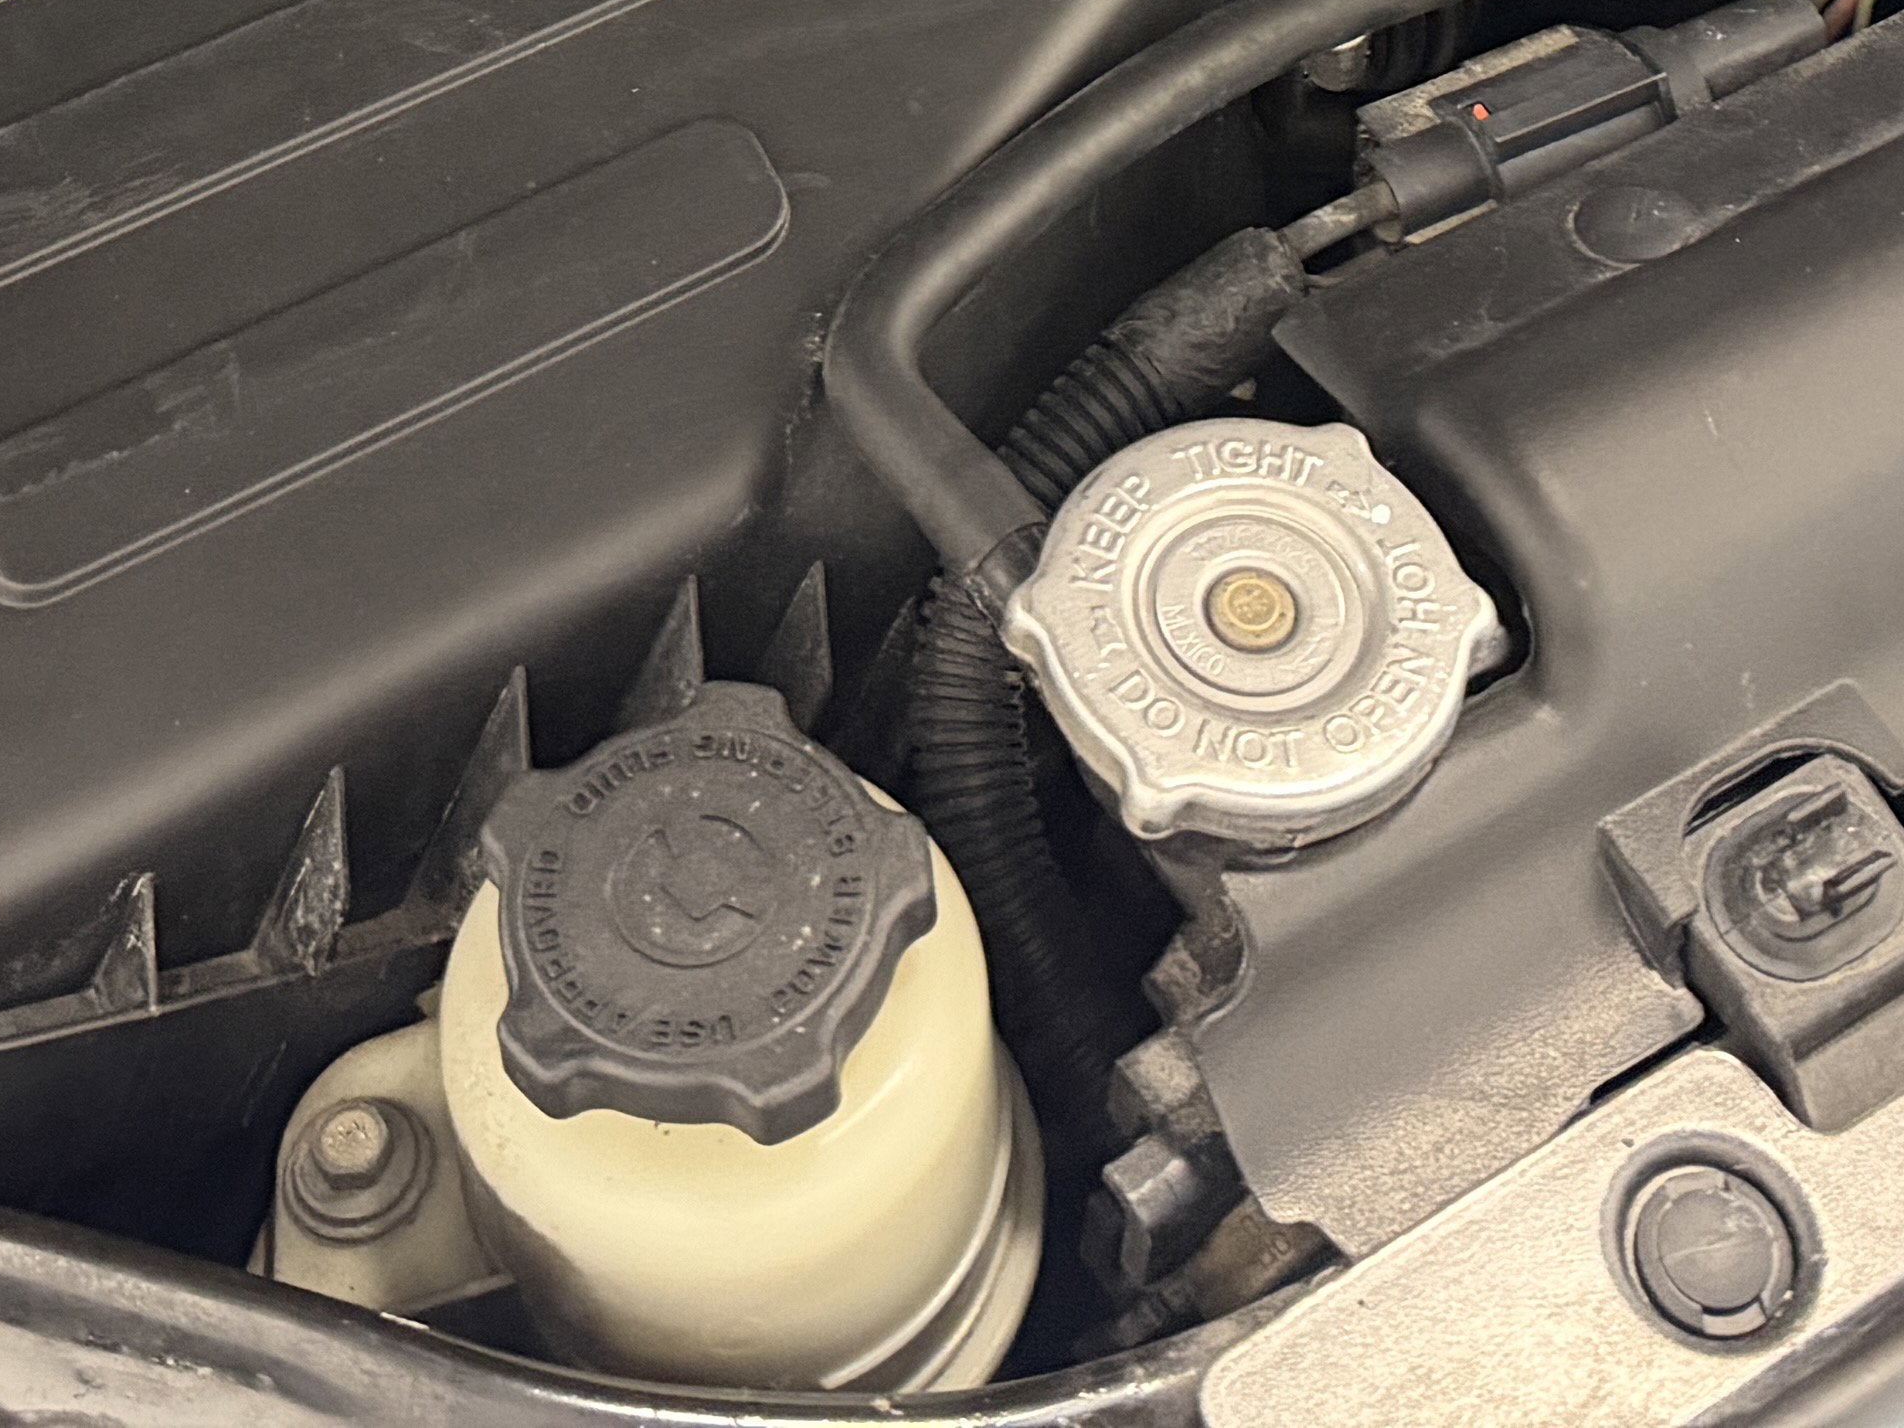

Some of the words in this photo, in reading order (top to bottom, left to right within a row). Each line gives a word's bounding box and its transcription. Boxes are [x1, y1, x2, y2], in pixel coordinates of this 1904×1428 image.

[1070, 474, 1157, 593] KEEP
[1172, 440, 1326, 488] TIGHT
[1377, 537, 1442, 632] HOT
[1108, 666, 1187, 738] DO
[1193, 718, 1304, 770] NOT
[1323, 645, 1436, 756] OPEN
[651, 1013, 739, 1046] USE
[768, 873, 863, 1013] POWER
